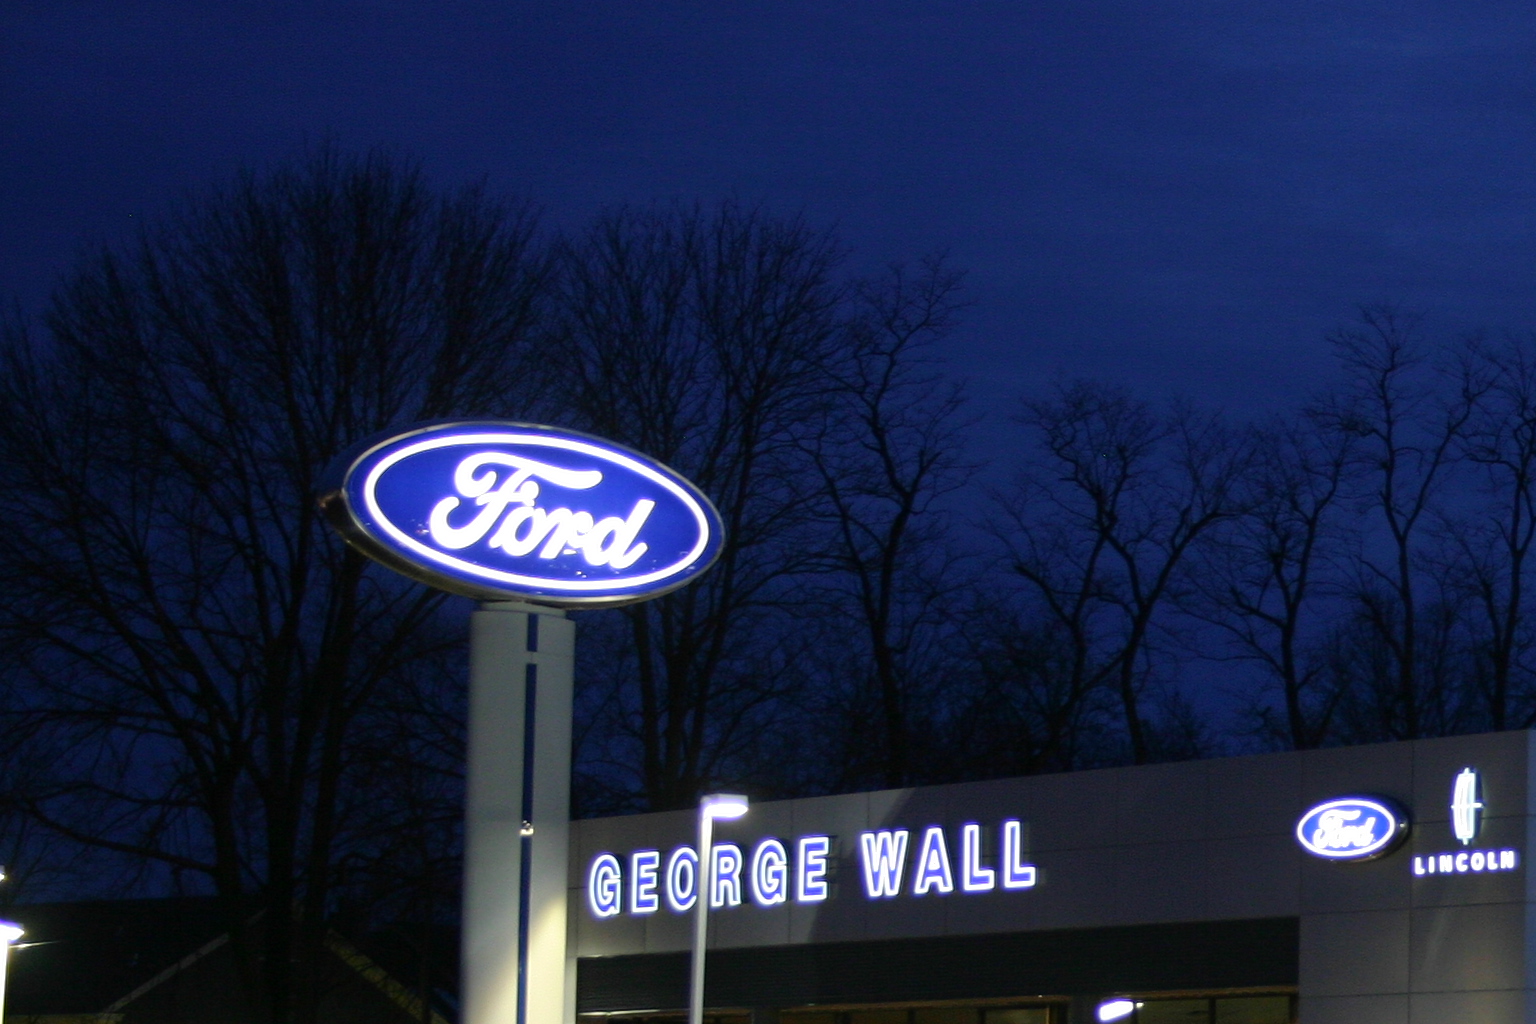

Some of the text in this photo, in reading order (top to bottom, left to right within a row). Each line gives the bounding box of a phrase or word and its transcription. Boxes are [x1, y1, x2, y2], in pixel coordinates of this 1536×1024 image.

[429, 451, 656, 569] Ford
[1312, 809, 1376, 848] Ford
[1413, 850, 1516, 875] LINCOLN
[589, 819, 1037, 917] GEORGE WALL
